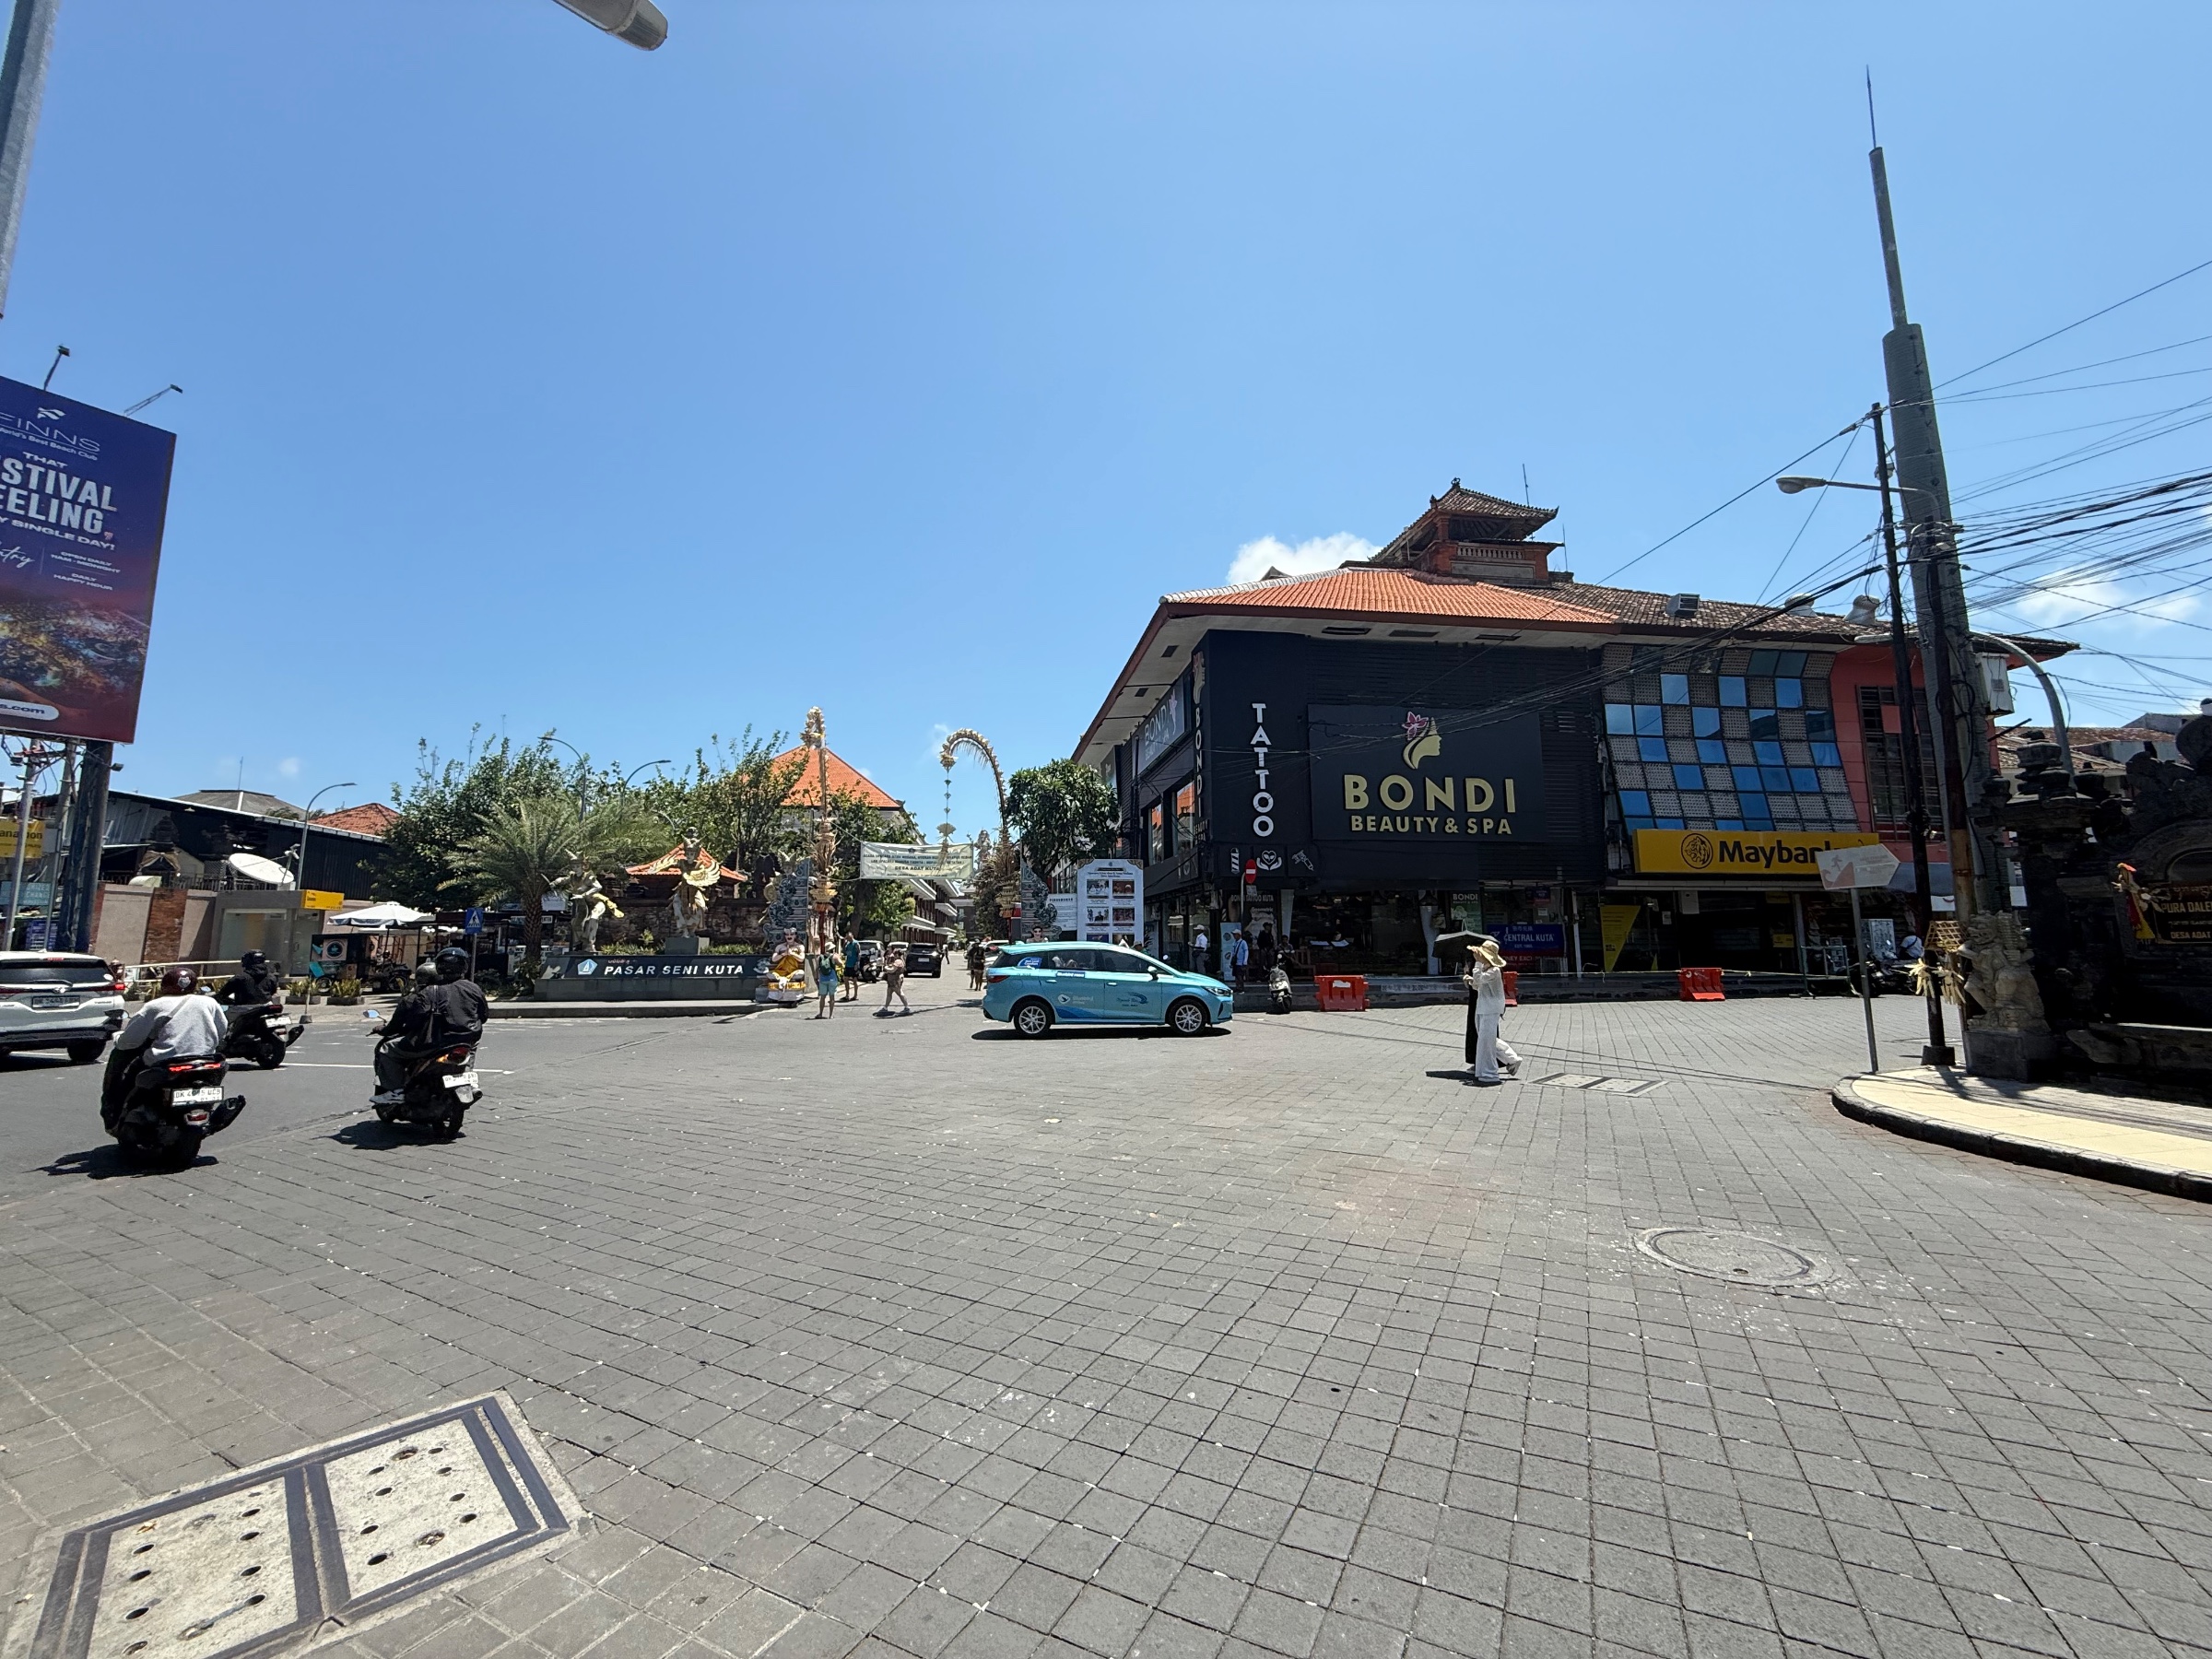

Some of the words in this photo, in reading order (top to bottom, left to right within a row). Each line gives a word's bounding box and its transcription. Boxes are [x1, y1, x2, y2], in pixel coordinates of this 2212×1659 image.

[22, 451, 68, 468] THAT
[0, 455, 117, 512] STIVAL
[0, 483, 104, 535] ELING
[11, 519, 76, 541] SINGLE
[76, 535, 115, 550] DAY!
[1145, 700, 1170, 747] BONDI
[1250, 703, 1274, 837] TATTOO
[1344, 774, 1516, 813] BONDI
[1351, 815, 1439, 833] BEAUTY
[1444, 817, 1459, 834] &
[1467, 818, 1512, 835] SPA
[1719, 840, 1841, 868] Mayban
[2187, 900, 2212, 912] DALE
[1503, 933, 1535, 942] CENTRAL
[2171, 931, 2191, 939] DESA
[604, 965, 655, 975] PASAR
[662, 965, 698, 975] SENI
[704, 964, 744, 974] KUTA
